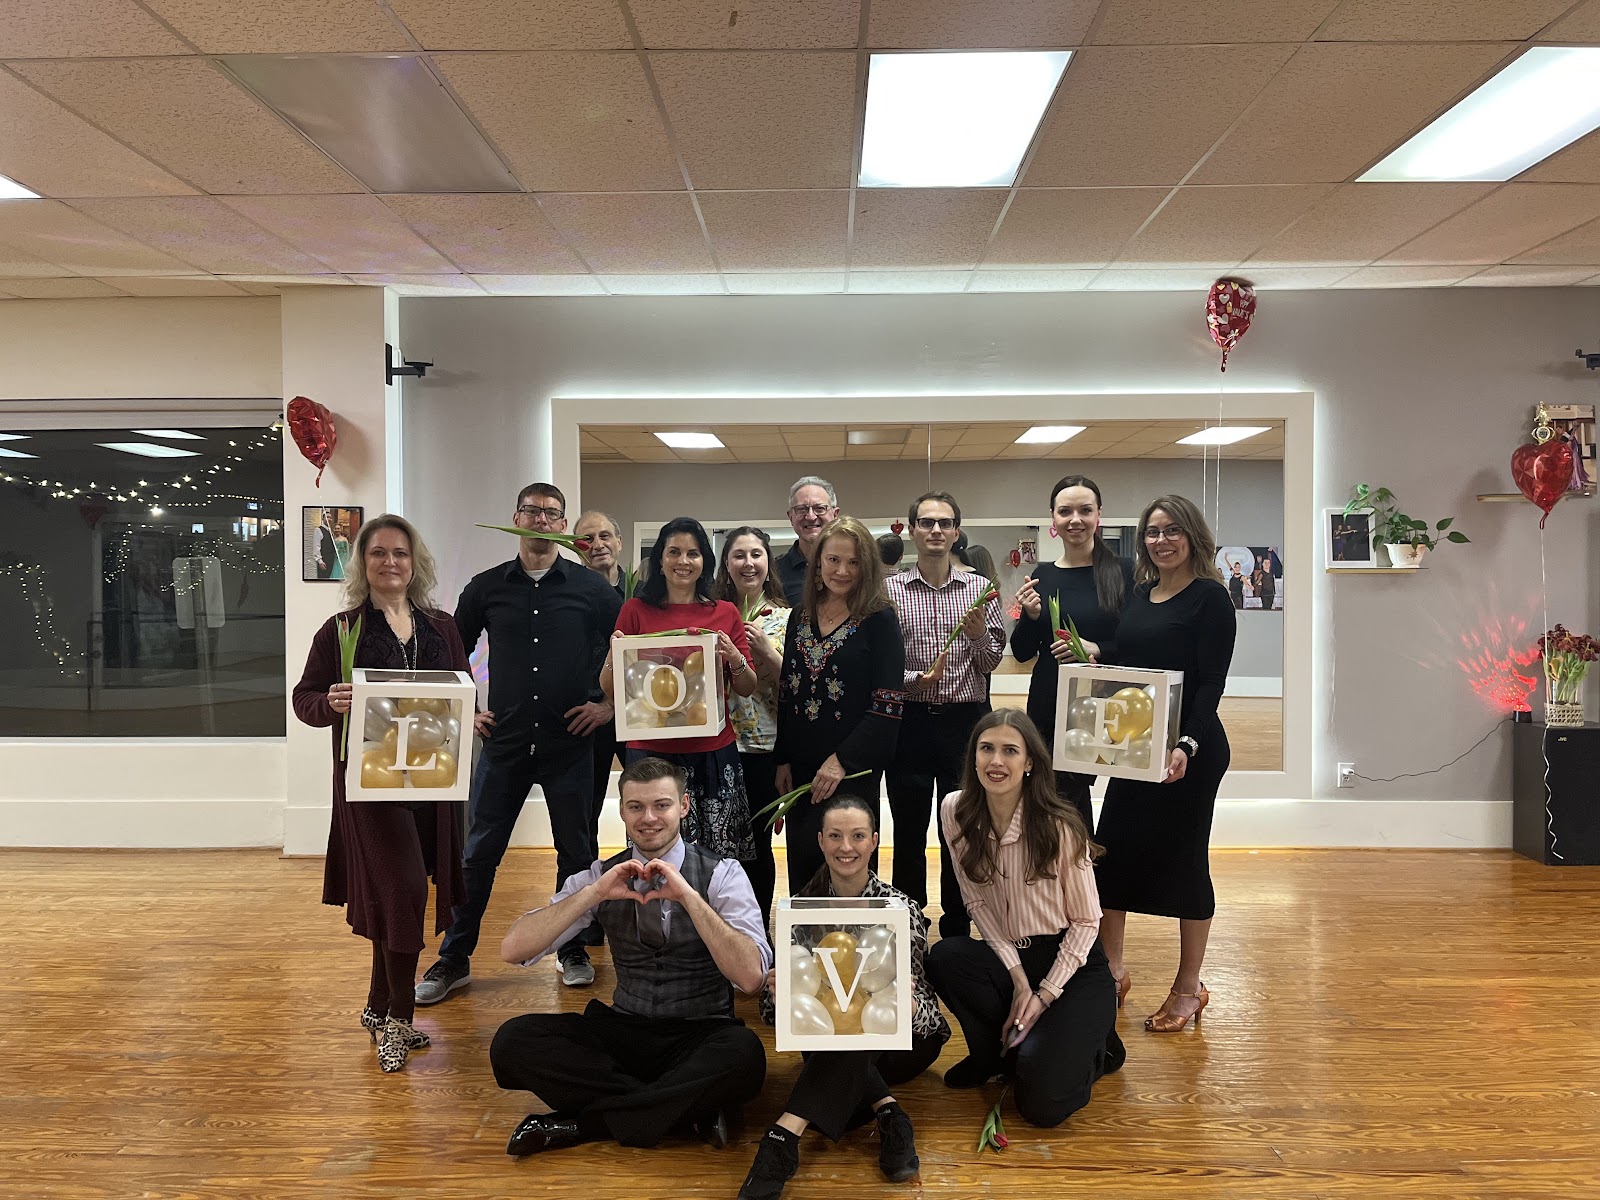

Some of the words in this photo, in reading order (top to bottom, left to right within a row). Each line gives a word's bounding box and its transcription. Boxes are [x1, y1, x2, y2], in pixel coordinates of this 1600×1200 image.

[643, 664, 687, 711] O
[387, 717, 437, 770] L
[1086, 697, 1131, 751] E
[811, 947, 877, 1013] V
